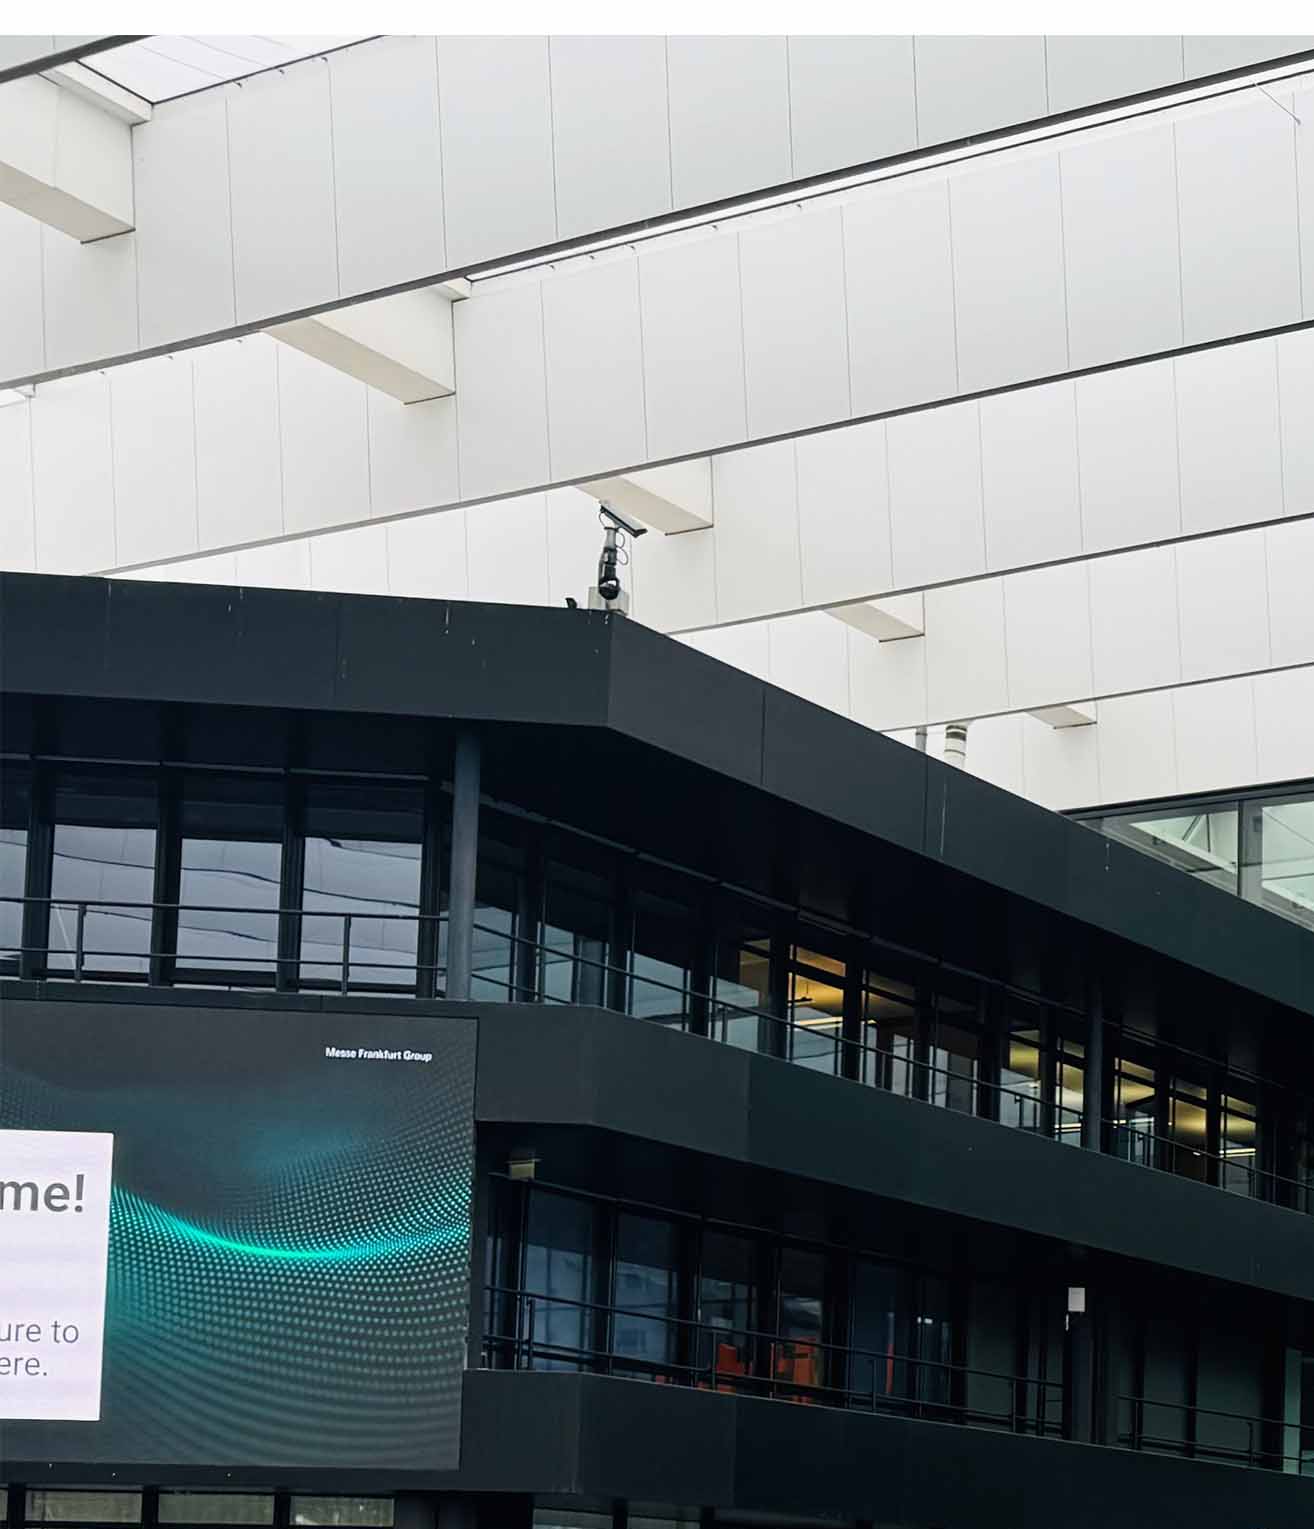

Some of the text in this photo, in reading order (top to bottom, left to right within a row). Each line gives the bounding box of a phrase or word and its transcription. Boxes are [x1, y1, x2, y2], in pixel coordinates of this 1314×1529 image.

[325, 1047, 433, 1062] Messe Frankfurt Group
[51, 1320, 79, 1344] to
